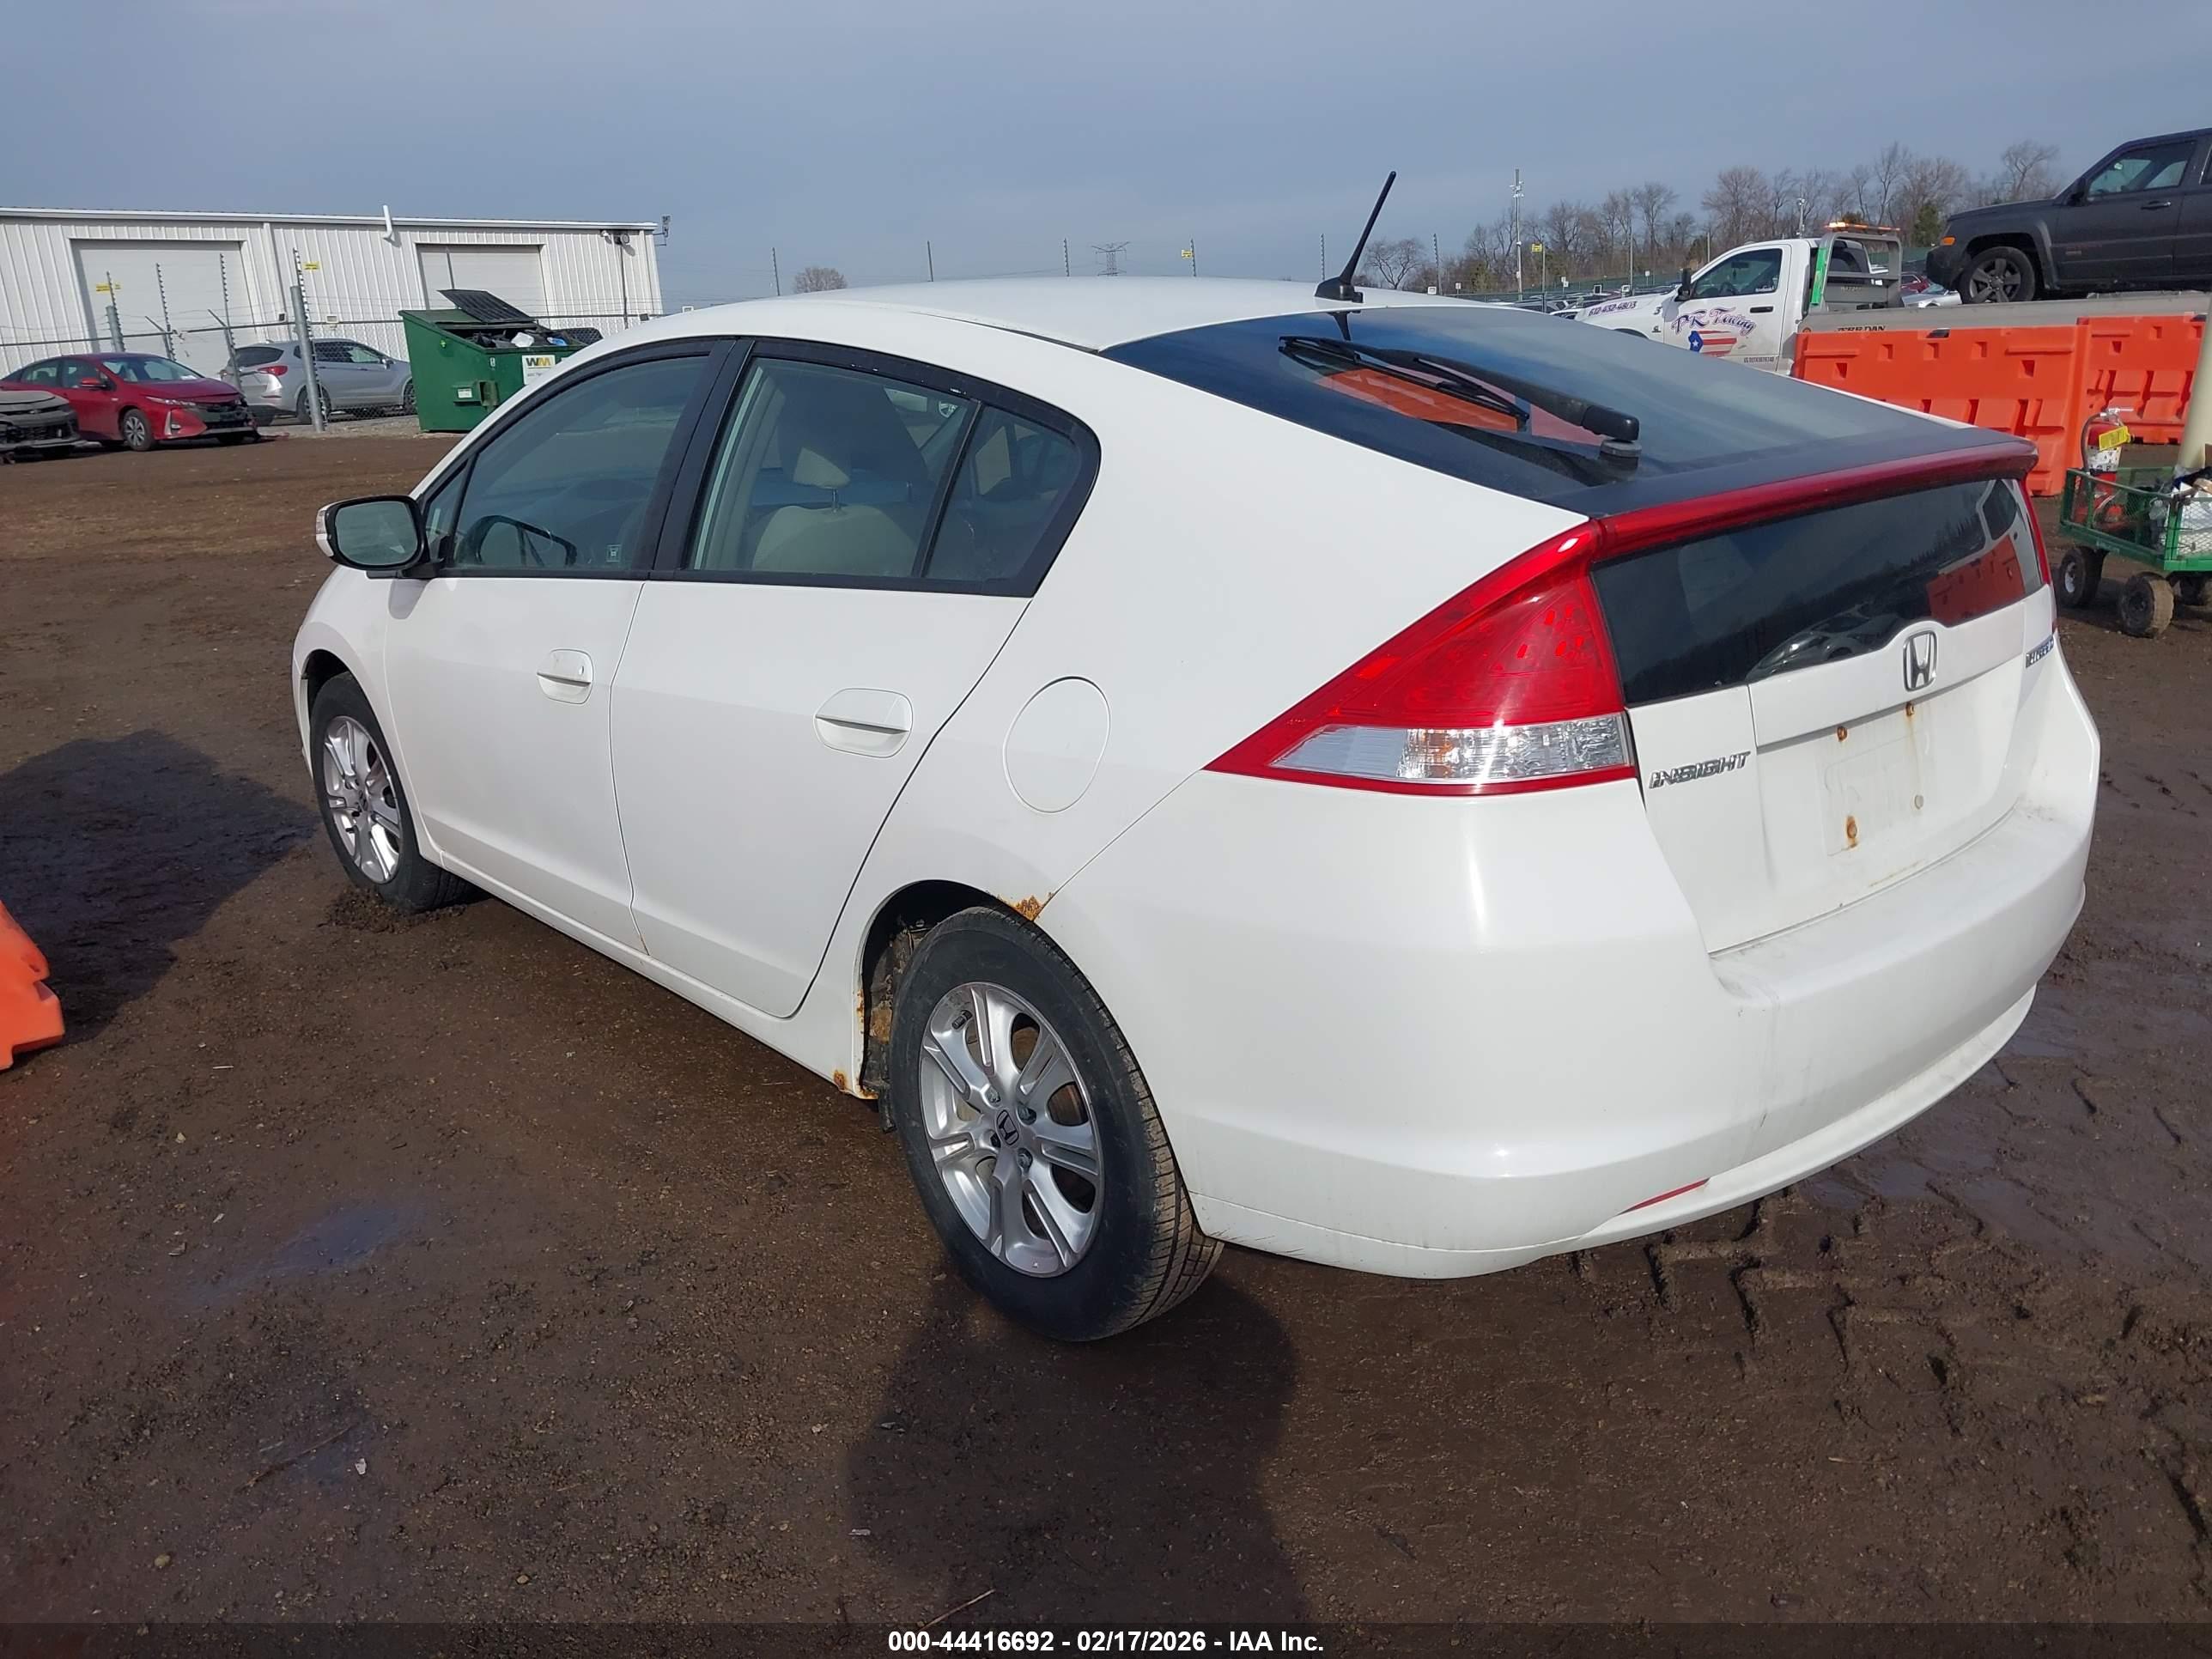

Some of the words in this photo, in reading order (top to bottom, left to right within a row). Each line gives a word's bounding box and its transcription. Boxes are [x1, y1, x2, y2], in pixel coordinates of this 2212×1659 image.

[1709, 307, 1757, 337] Towing
[526, 357, 551, 367] WM
[1649, 751, 1751, 789] INSIGHT
